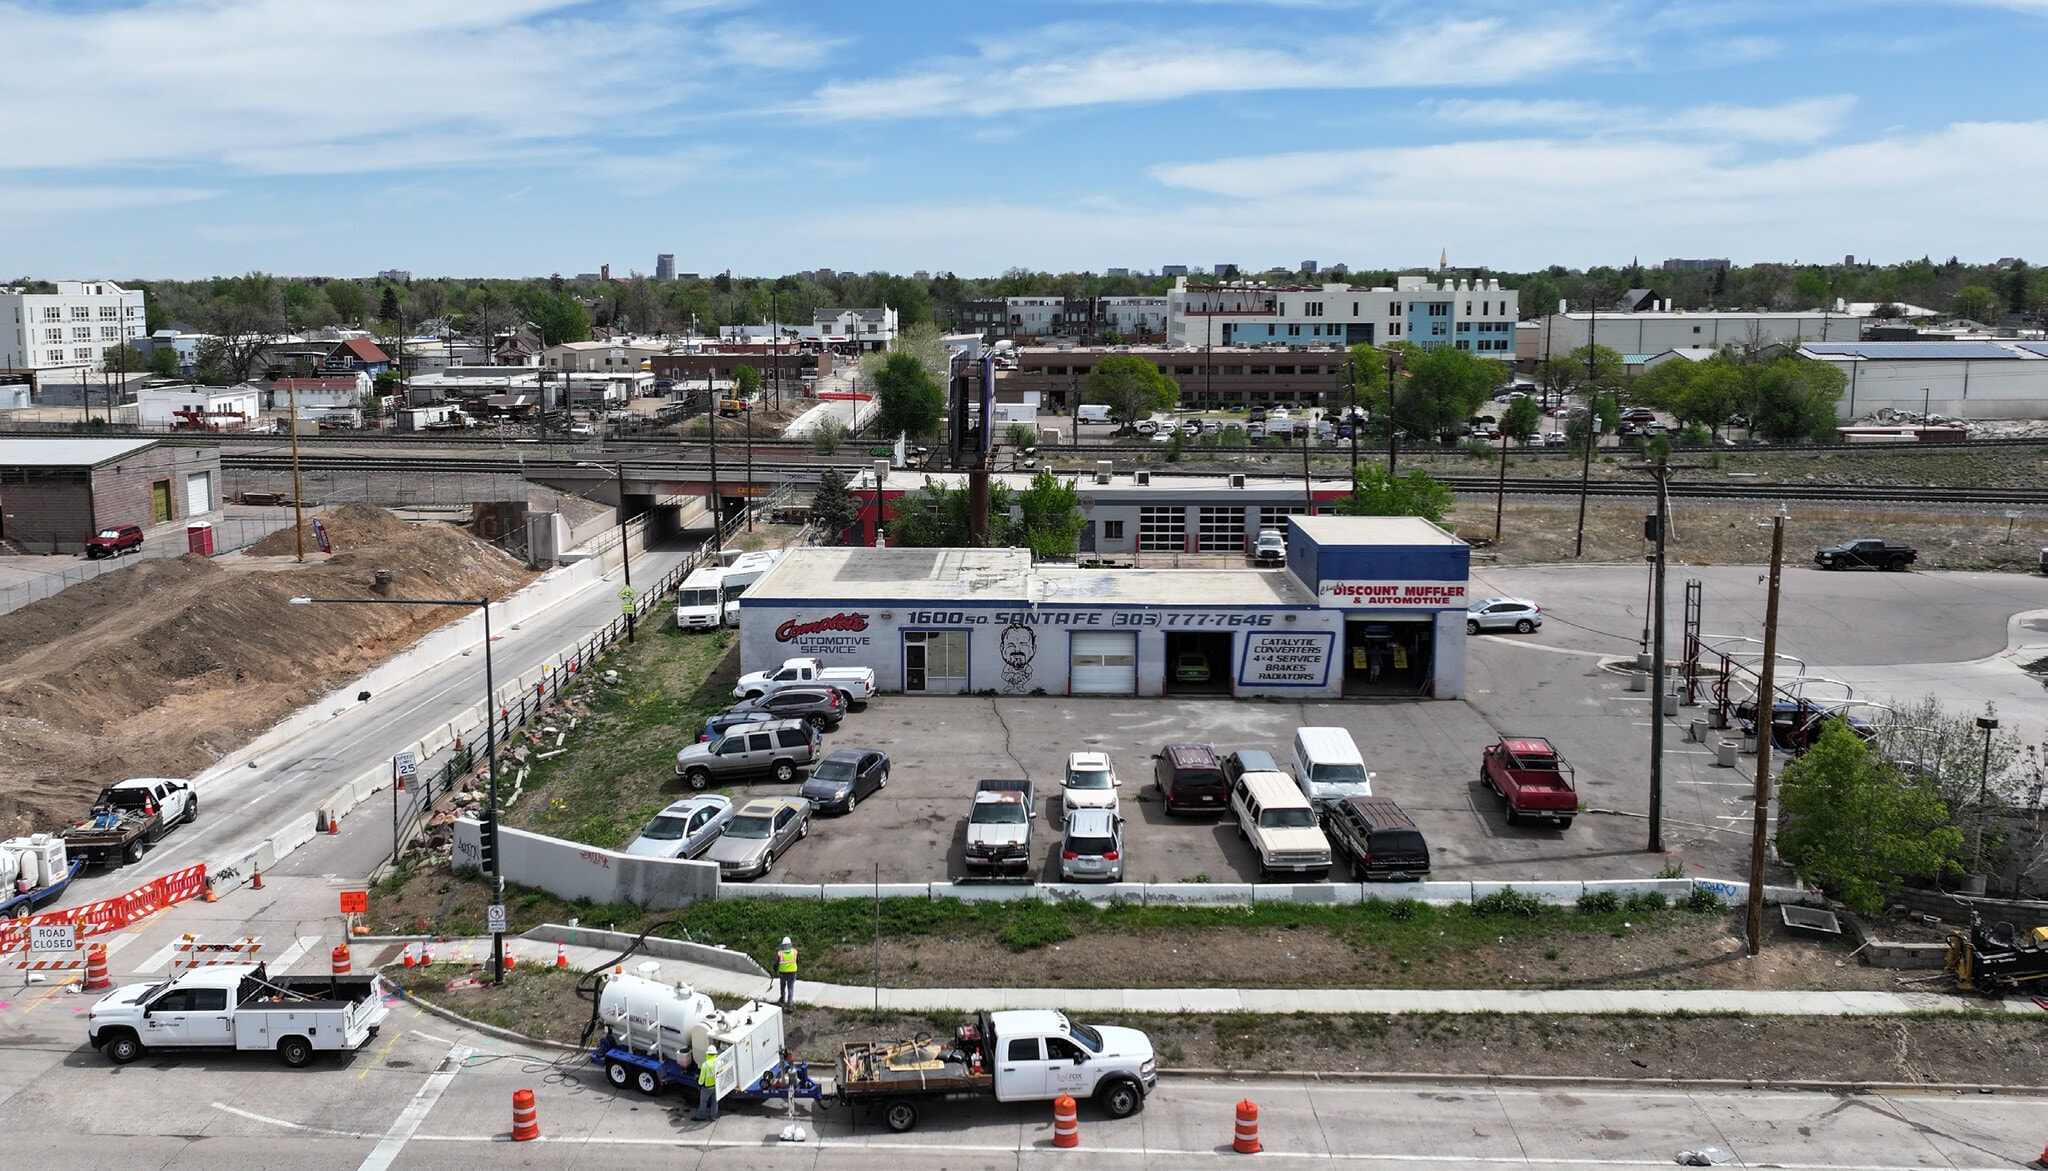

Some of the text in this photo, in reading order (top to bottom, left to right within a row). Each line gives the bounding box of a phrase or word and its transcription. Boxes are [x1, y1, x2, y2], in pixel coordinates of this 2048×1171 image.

[1333, 586, 1399, 596] DISCOUNT
[1404, 586, 1465, 597] MUFFLER
[908, 611, 964, 624] 1600
[1111, 611, 1163, 628] (303)
[1167, 613, 1274, 626] 777-7646
[775, 611, 870, 643] Complete
[791, 636, 871, 646] AUTOMOTIVE
[1261, 638, 1317, 646] CATALYTIC
[800, 645, 857, 654] SERVICE
[1254, 646, 1322, 654] CONVERTERS
[1275, 655, 1322, 663] SERVICE
[1265, 663, 1307, 672] BRAKES
[1258, 673, 1315, 681] RADIATORS
[400, 763, 416, 775] 25
[39, 929, 66, 938] ROAD
[33, 939, 73, 949] CLOSED
